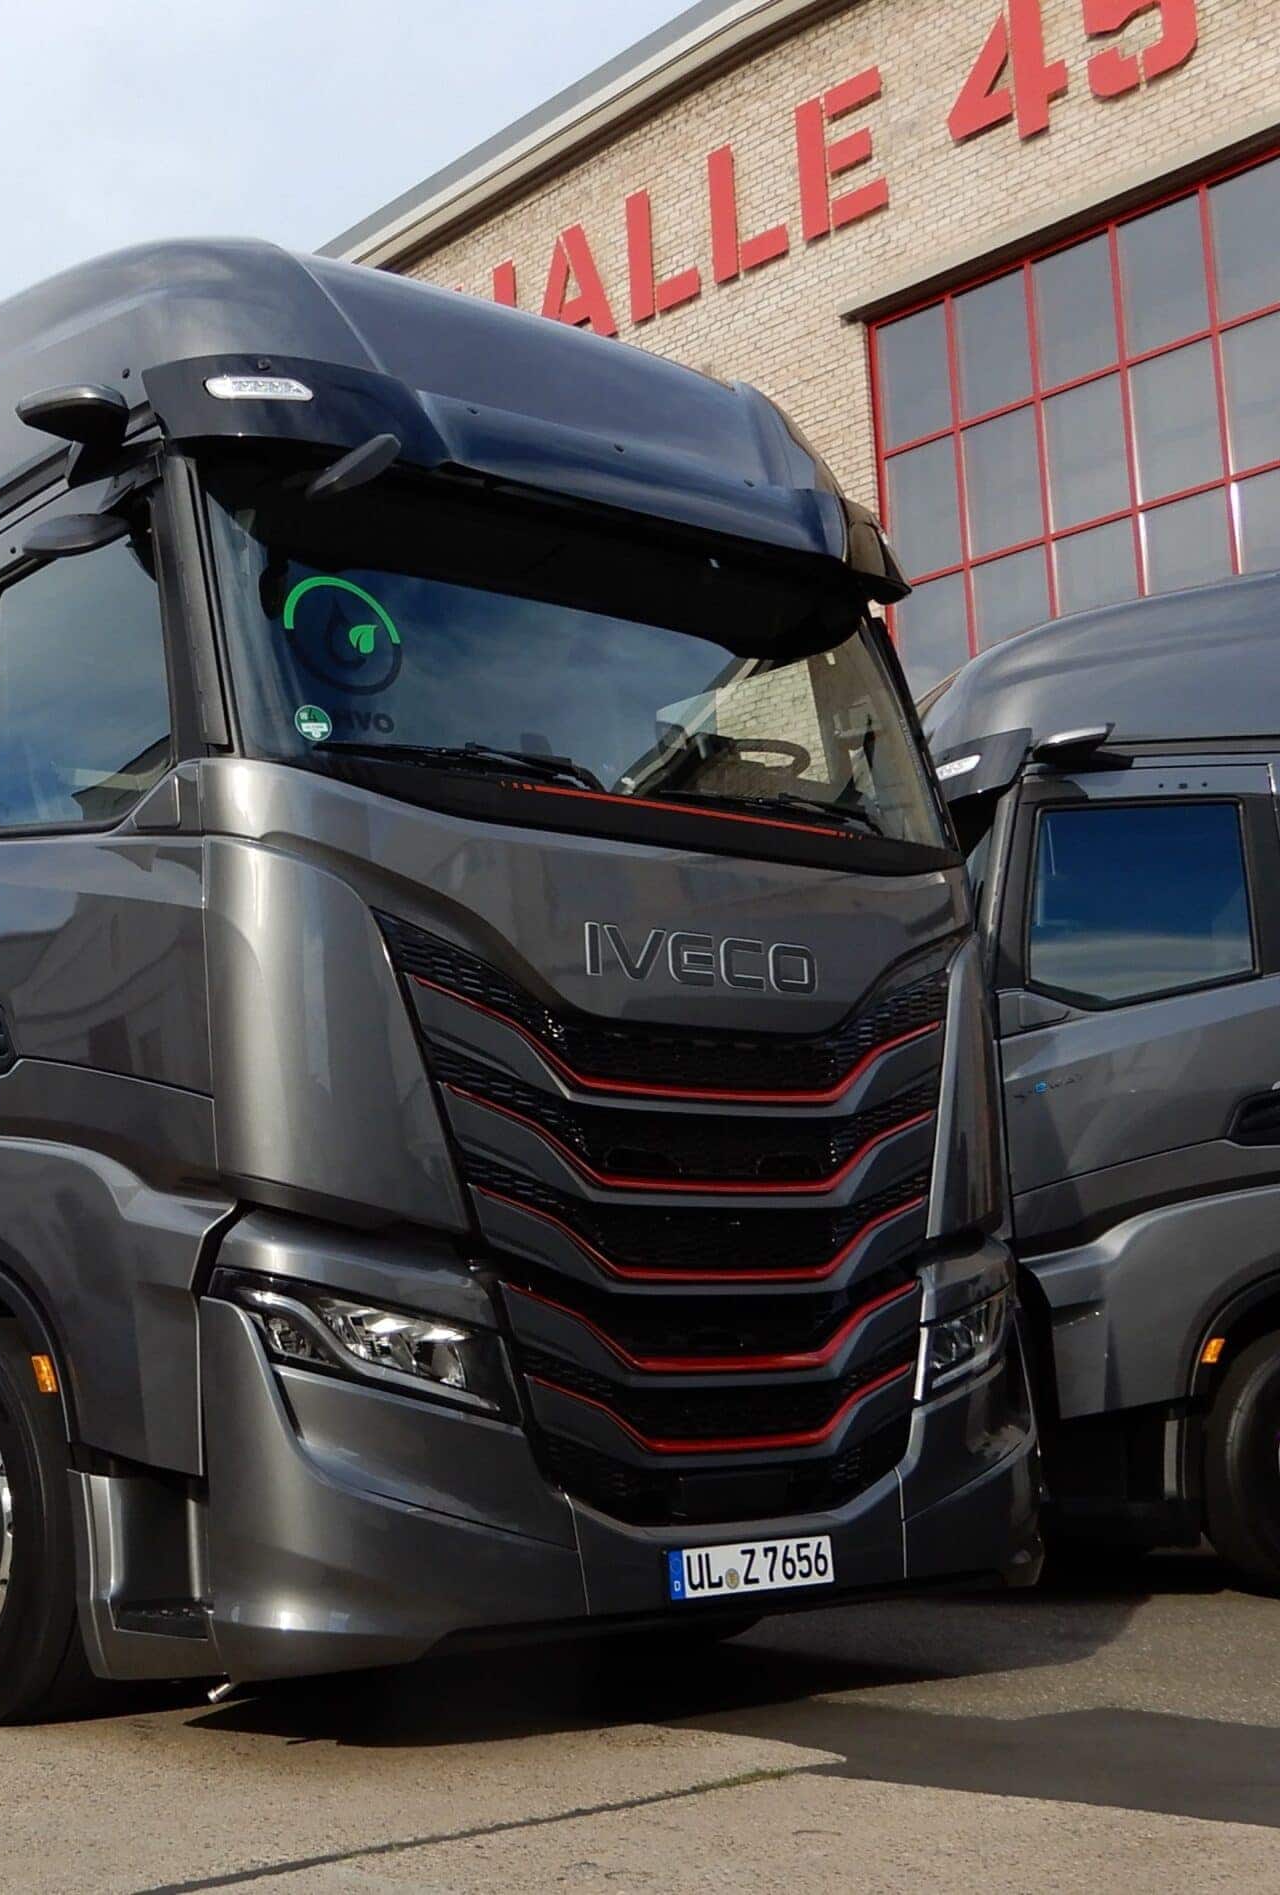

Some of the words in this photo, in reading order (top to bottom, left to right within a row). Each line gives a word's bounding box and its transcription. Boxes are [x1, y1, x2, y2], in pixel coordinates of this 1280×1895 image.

[454, 65, 889, 337] ALLE
[946, 0, 1199, 140] 45
[584, 921, 818, 994] IVECO
[686, 1552, 723, 1590] UL
